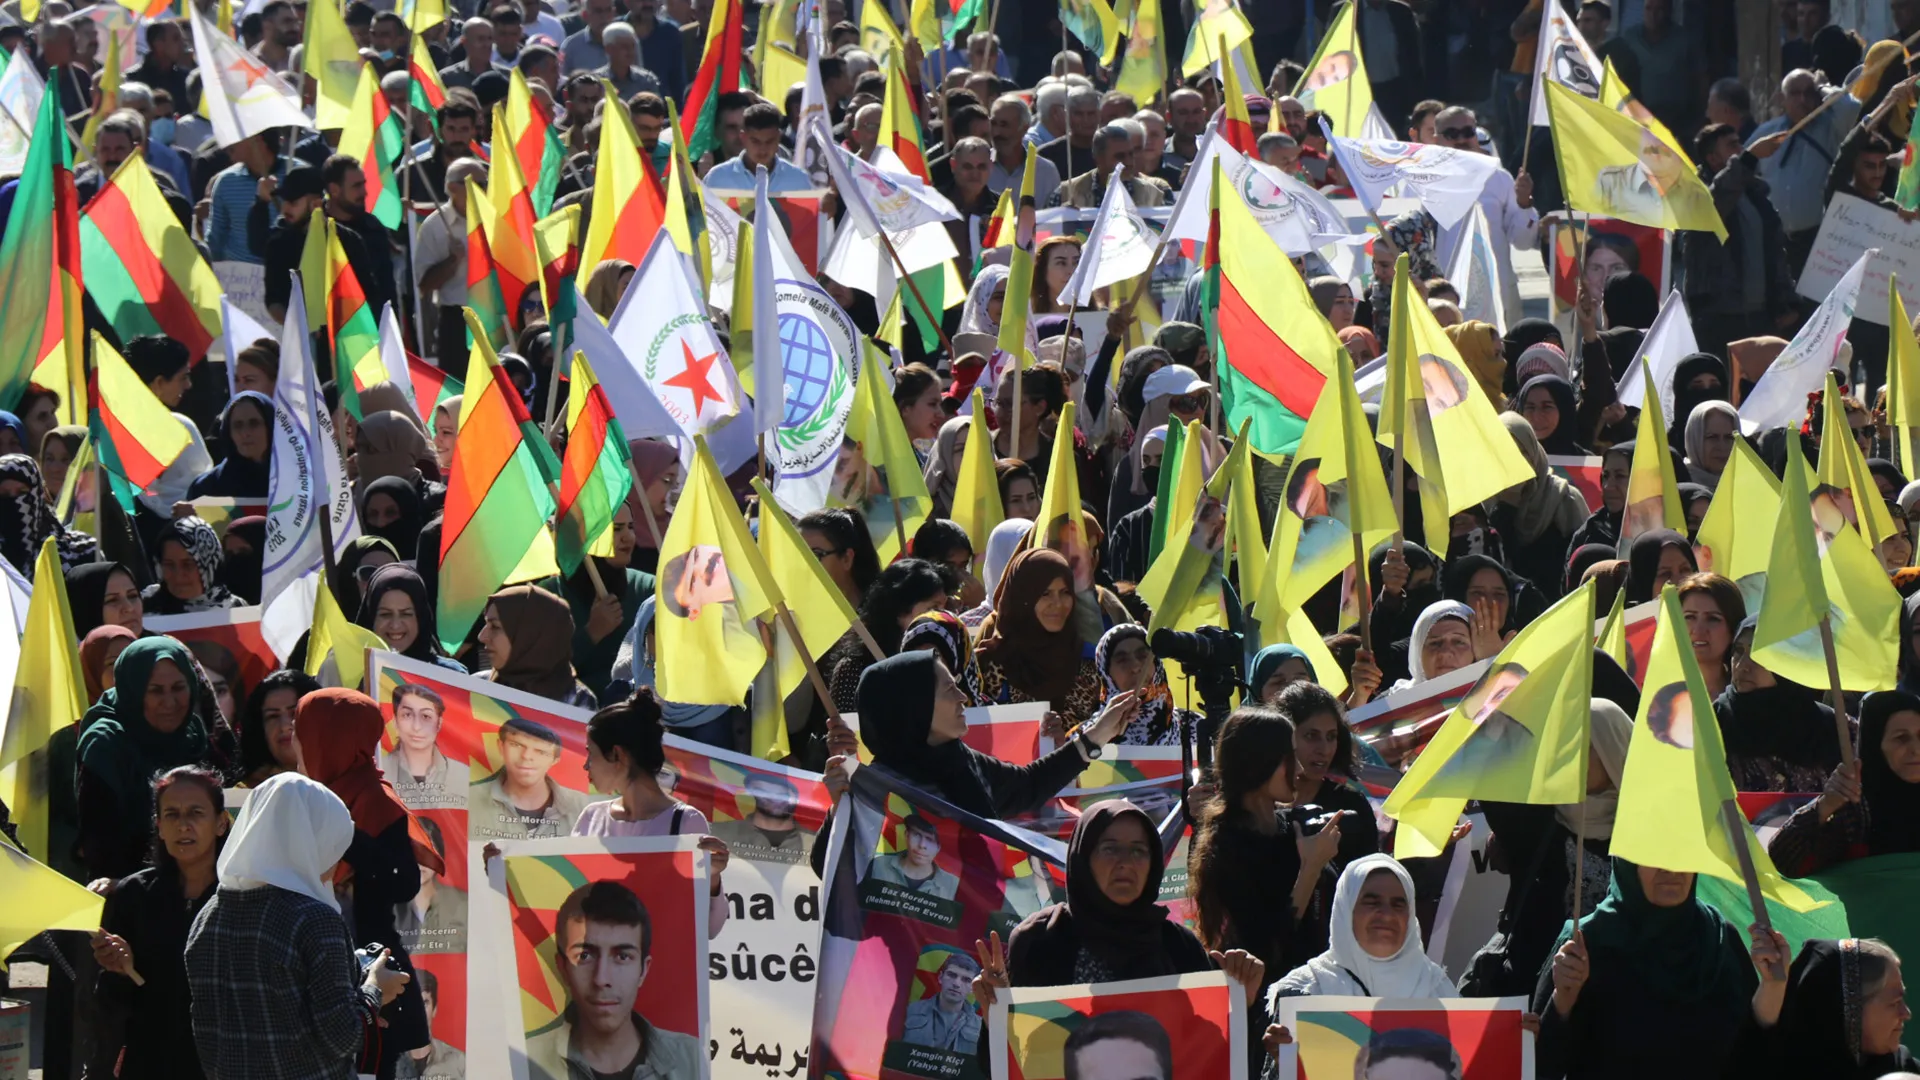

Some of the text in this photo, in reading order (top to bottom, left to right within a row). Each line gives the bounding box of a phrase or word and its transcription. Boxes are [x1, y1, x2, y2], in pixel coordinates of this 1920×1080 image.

[499, 814, 560, 826] Baz Mordem
[482, 827, 523, 839] Mehmet
[881, 887, 938, 908] Baz Mordem
[865, 895, 953, 924] (Mehmet Can Evren)
[428, 941, 444, 949] Ete
[709, 942, 816, 983] sûcê
[907, 1059, 938, 1072] (Yahya
